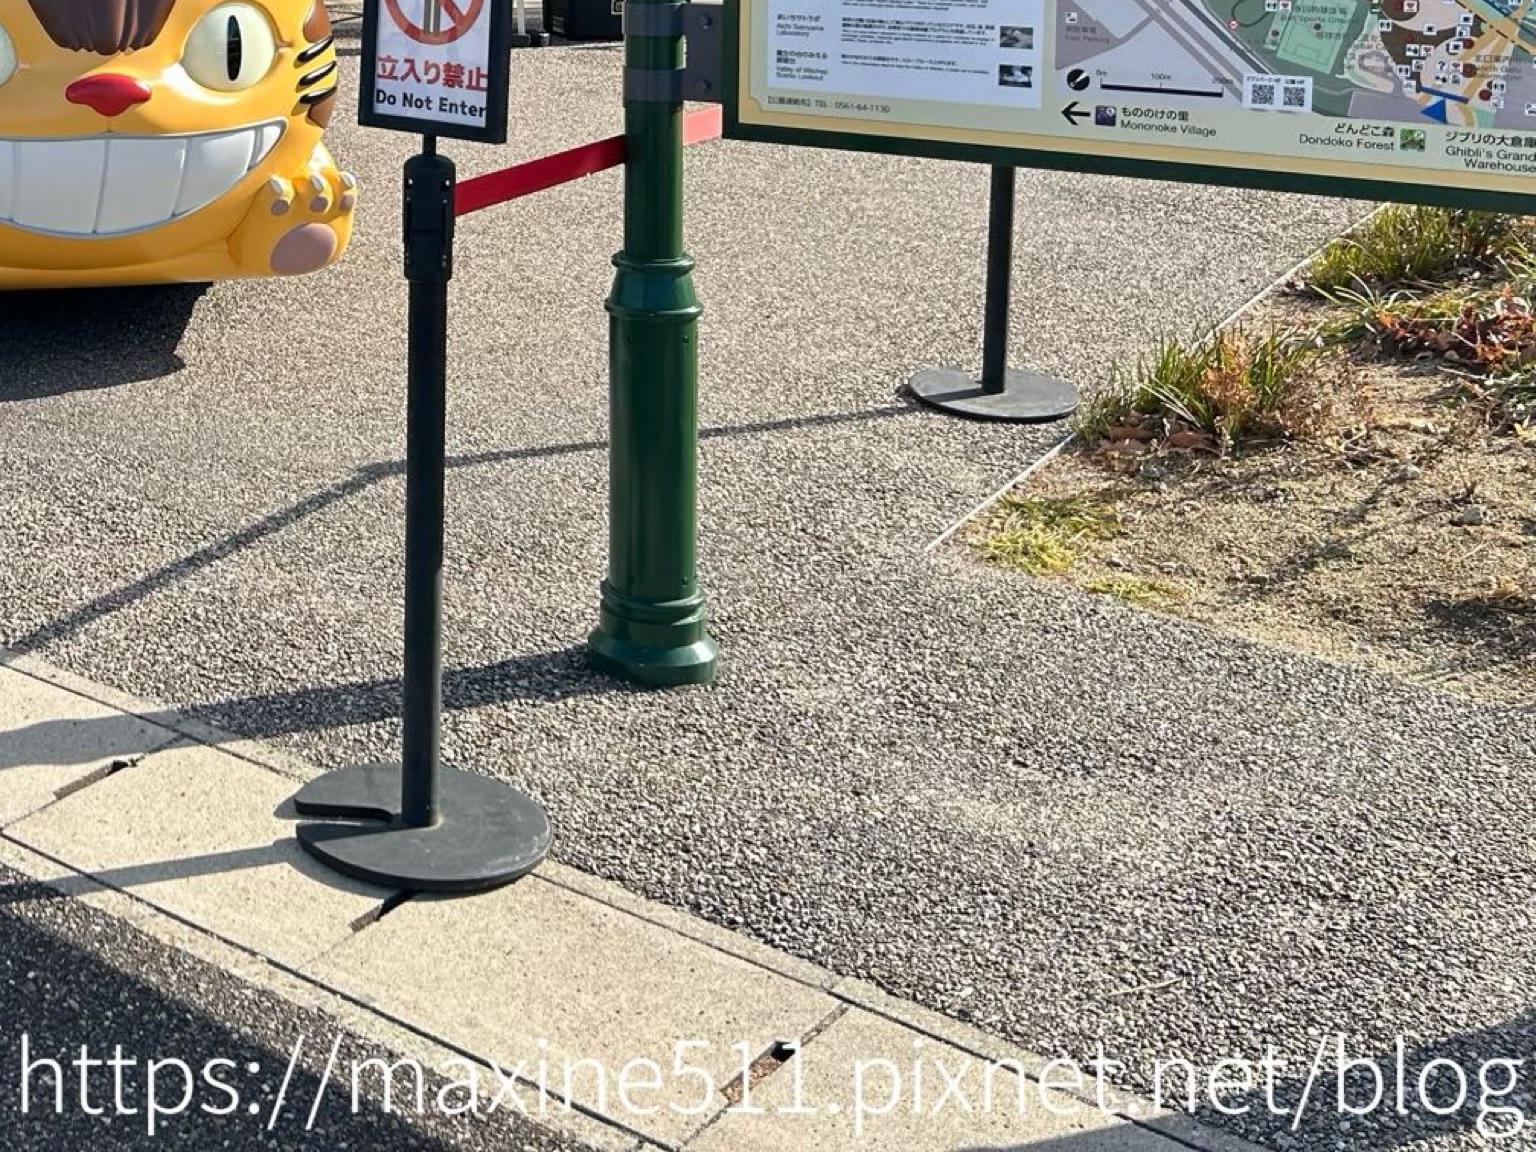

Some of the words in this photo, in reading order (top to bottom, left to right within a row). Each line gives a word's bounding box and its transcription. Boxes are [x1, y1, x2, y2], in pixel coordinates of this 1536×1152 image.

[377, 55, 488, 92] 立入り禁止
[1151, 72, 1171, 80] 100m
[376, 89, 397, 105] Do
[401, 92, 433, 111] Not
[438, 97, 487, 118] Enter
[1121, 106, 1189, 122] もののけの里
[1120, 120, 1177, 134] Mononoke
[1179, 123, 1217, 137] Village
[1334, 122, 1394, 138] どんどこ森
[1299, 134, 1353, 147] Dondoko
[1356, 139, 1395, 151] Forest
[1445, 145, 1493, 159] Ghibli's
